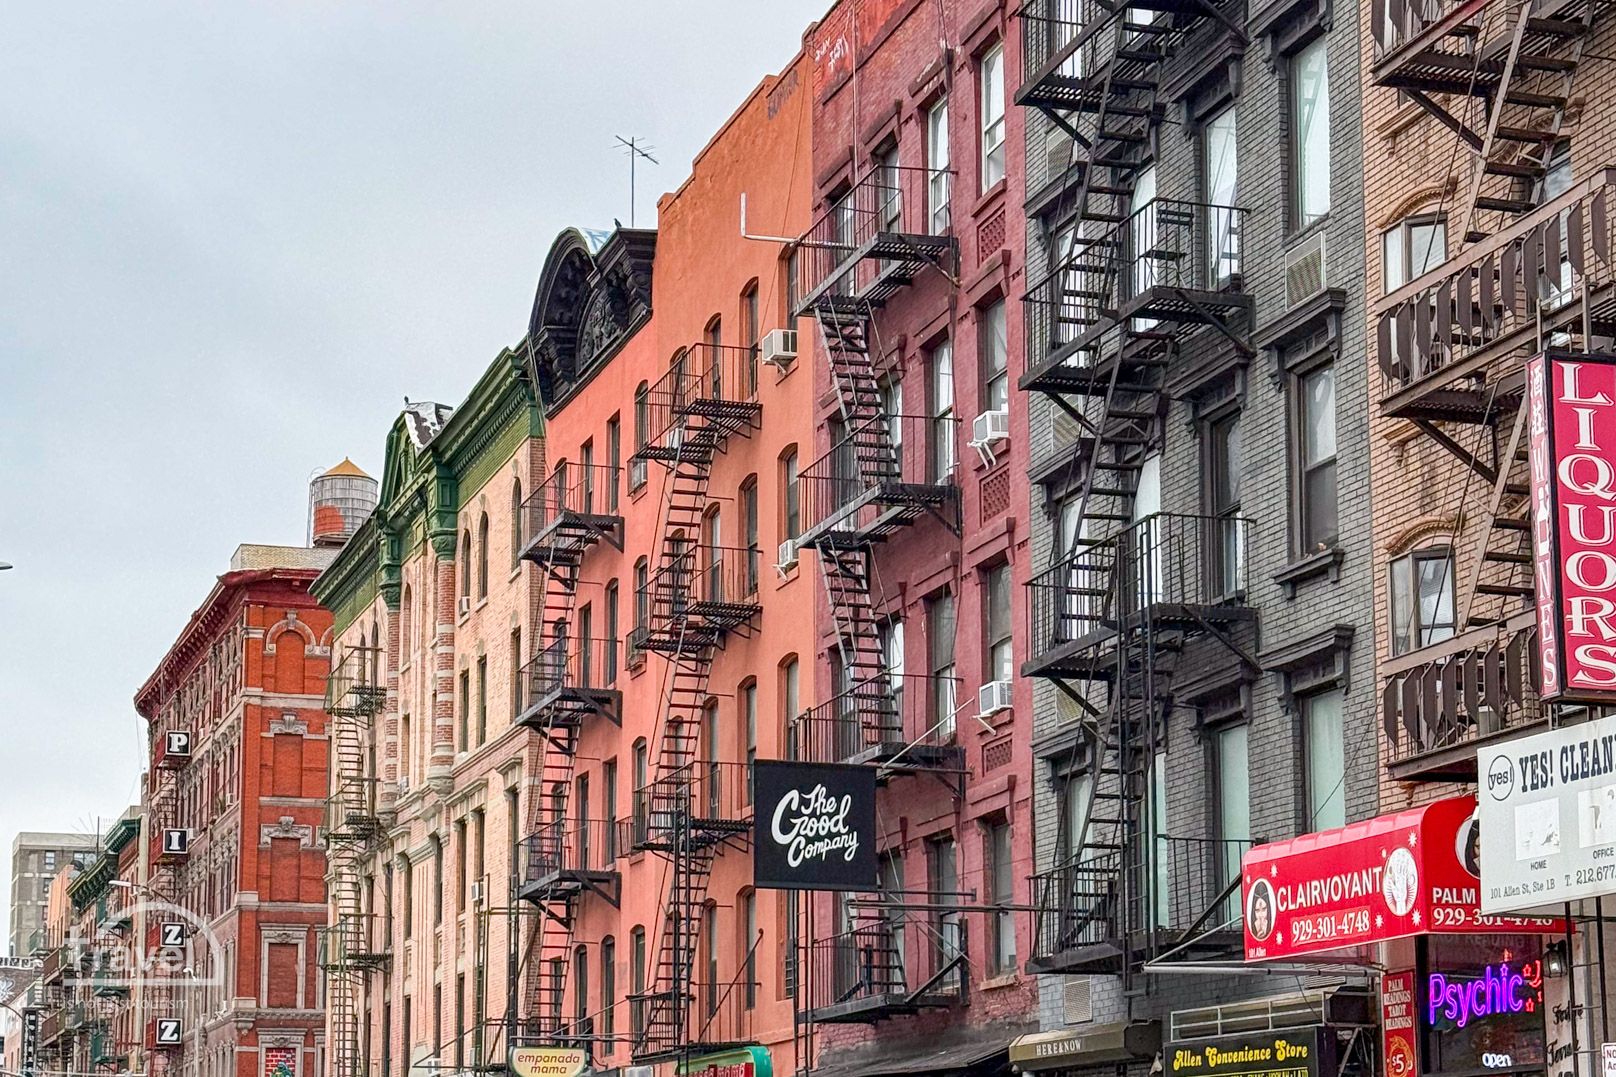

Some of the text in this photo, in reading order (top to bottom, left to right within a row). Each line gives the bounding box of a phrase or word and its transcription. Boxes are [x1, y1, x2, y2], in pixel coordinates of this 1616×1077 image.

[1558, 362, 1616, 685] LIQUORS
[1489, 766, 1512, 791] yes!
[1518, 734, 1616, 793] YES! CLEAN
[801, 783, 837, 815] The
[771, 789, 852, 844] Good
[787, 831, 859, 867] Company
[1592, 847, 1614, 859] OFFICE
[1530, 859, 1547, 871] HOME
[1276, 866, 1383, 912] CLAIRVOYANT
[1432, 887, 1476, 905] PALM
[1490, 887, 1502, 899] 101
[1503, 885, 1521, 898] Allen
[1292, 909, 1370, 944] 929-301-4748
[1429, 963, 1523, 1027] Psychic
[517, 1053, 580, 1065] empanada
[531, 1065, 567, 1074] mama
[1173, 1039, 1308, 1070] Allen Convenience Store
[1392, 1053, 1405, 1073] $5
